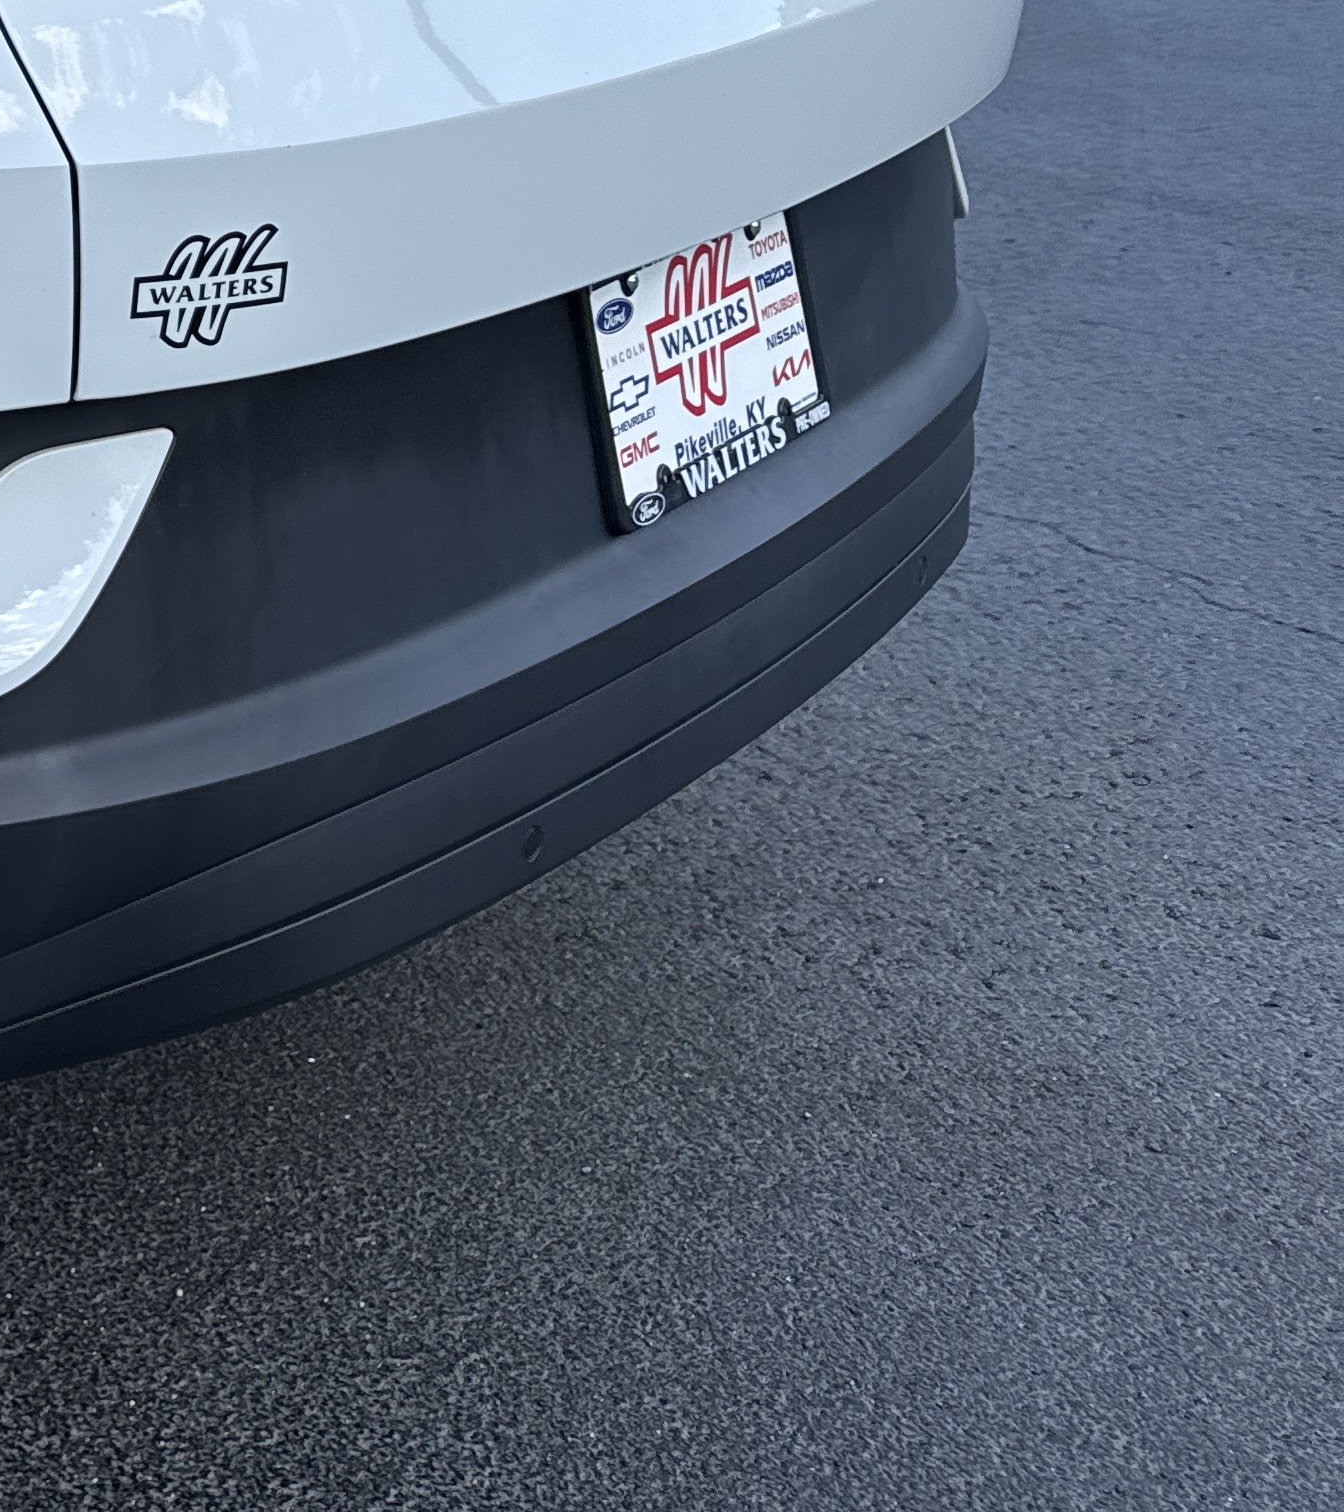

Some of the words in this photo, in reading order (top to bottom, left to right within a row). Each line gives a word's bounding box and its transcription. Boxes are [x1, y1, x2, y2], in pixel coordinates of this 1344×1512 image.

[748, 230, 788, 260] TOYOTA
[150, 275, 274, 305] WALTERS
[761, 291, 800, 322] MITSUBISHI
[660, 297, 748, 359] WALTERS
[766, 319, 805, 351] NISSAN
[612, 406, 656, 436] CHEVROLET
[674, 417, 742, 468] Pikeville,
[746, 396, 766, 427] KY
[620, 431, 660, 468] GMC
[680, 416, 787, 499] WALTERS
